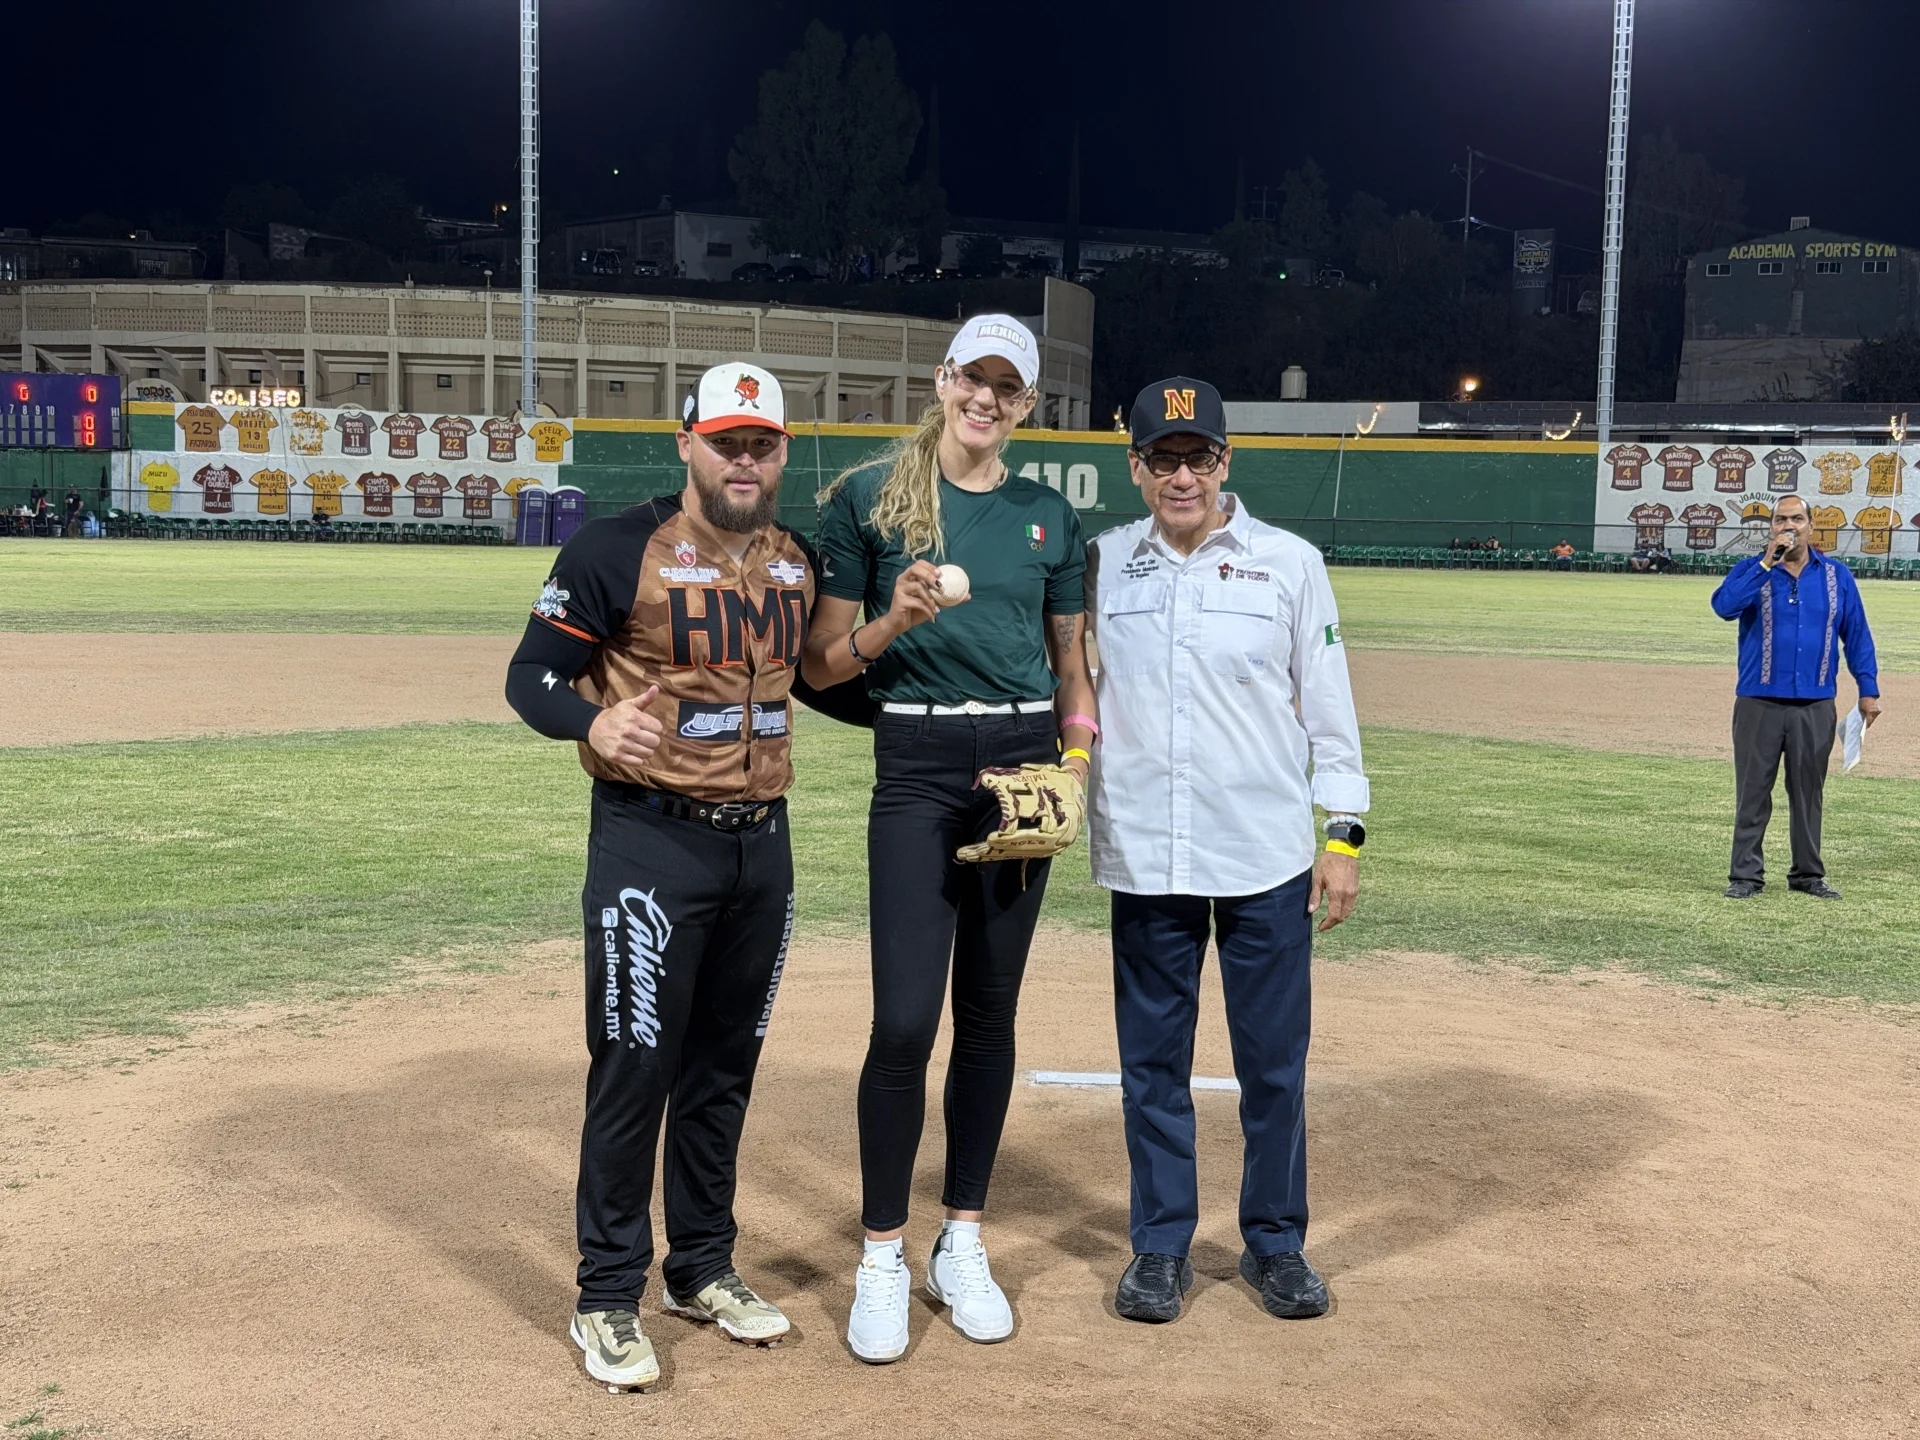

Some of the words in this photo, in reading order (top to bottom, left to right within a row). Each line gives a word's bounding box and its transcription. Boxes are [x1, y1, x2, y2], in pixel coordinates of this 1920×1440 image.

[1728, 243, 1796, 260] ACADEMIA
[1805, 243, 1861, 258] SPORTS
[1864, 243, 1897, 258] GYM
[210, 389, 301, 407] COLISEO
[9, 404, 15, 414] 7
[22, 405, 28, 415] 8
[35, 405, 41, 415] 9
[46, 406, 55, 416] 10
[1164, 389, 1196, 421] N
[191, 421, 213, 435] 25
[390, 420, 416, 428] IVAN
[247, 431, 261, 440] 13
[442, 430, 465, 438] VILLA
[490, 431, 514, 439] VALDEZ
[543, 426, 563, 436] FELIX
[350, 435, 360, 447] 11
[399, 437, 408, 447] 5
[446, 438, 460, 449] 22
[495, 440, 511, 451] 27
[544, 436, 556, 445] 26
[441, 450, 465, 458] NOGALES
[1622, 467, 1631, 478] 4
[1675, 468, 1683, 479] 7
[1723, 469, 1738, 480] 14
[1774, 472, 1790, 484] 27
[366, 485, 391, 494] FONTES
[1018, 462, 1099, 509] 410
[472, 498, 486, 508] 23
[1738, 491, 1778, 505] JOAQUIN
[1688, 510, 1718, 519] CHUKAS
[1644, 527, 1657, 538] 11
[1695, 528, 1711, 538] 27
[1869, 530, 1884, 543] 14
[1235, 568, 1269, 577] FRONTERA
[1247, 575, 1270, 583] TODOS
[761, 891, 795, 1021] PAQUETEXPRESS
[619, 887, 674, 1048] Caliente
[604, 929, 621, 1042] caliente.mx
